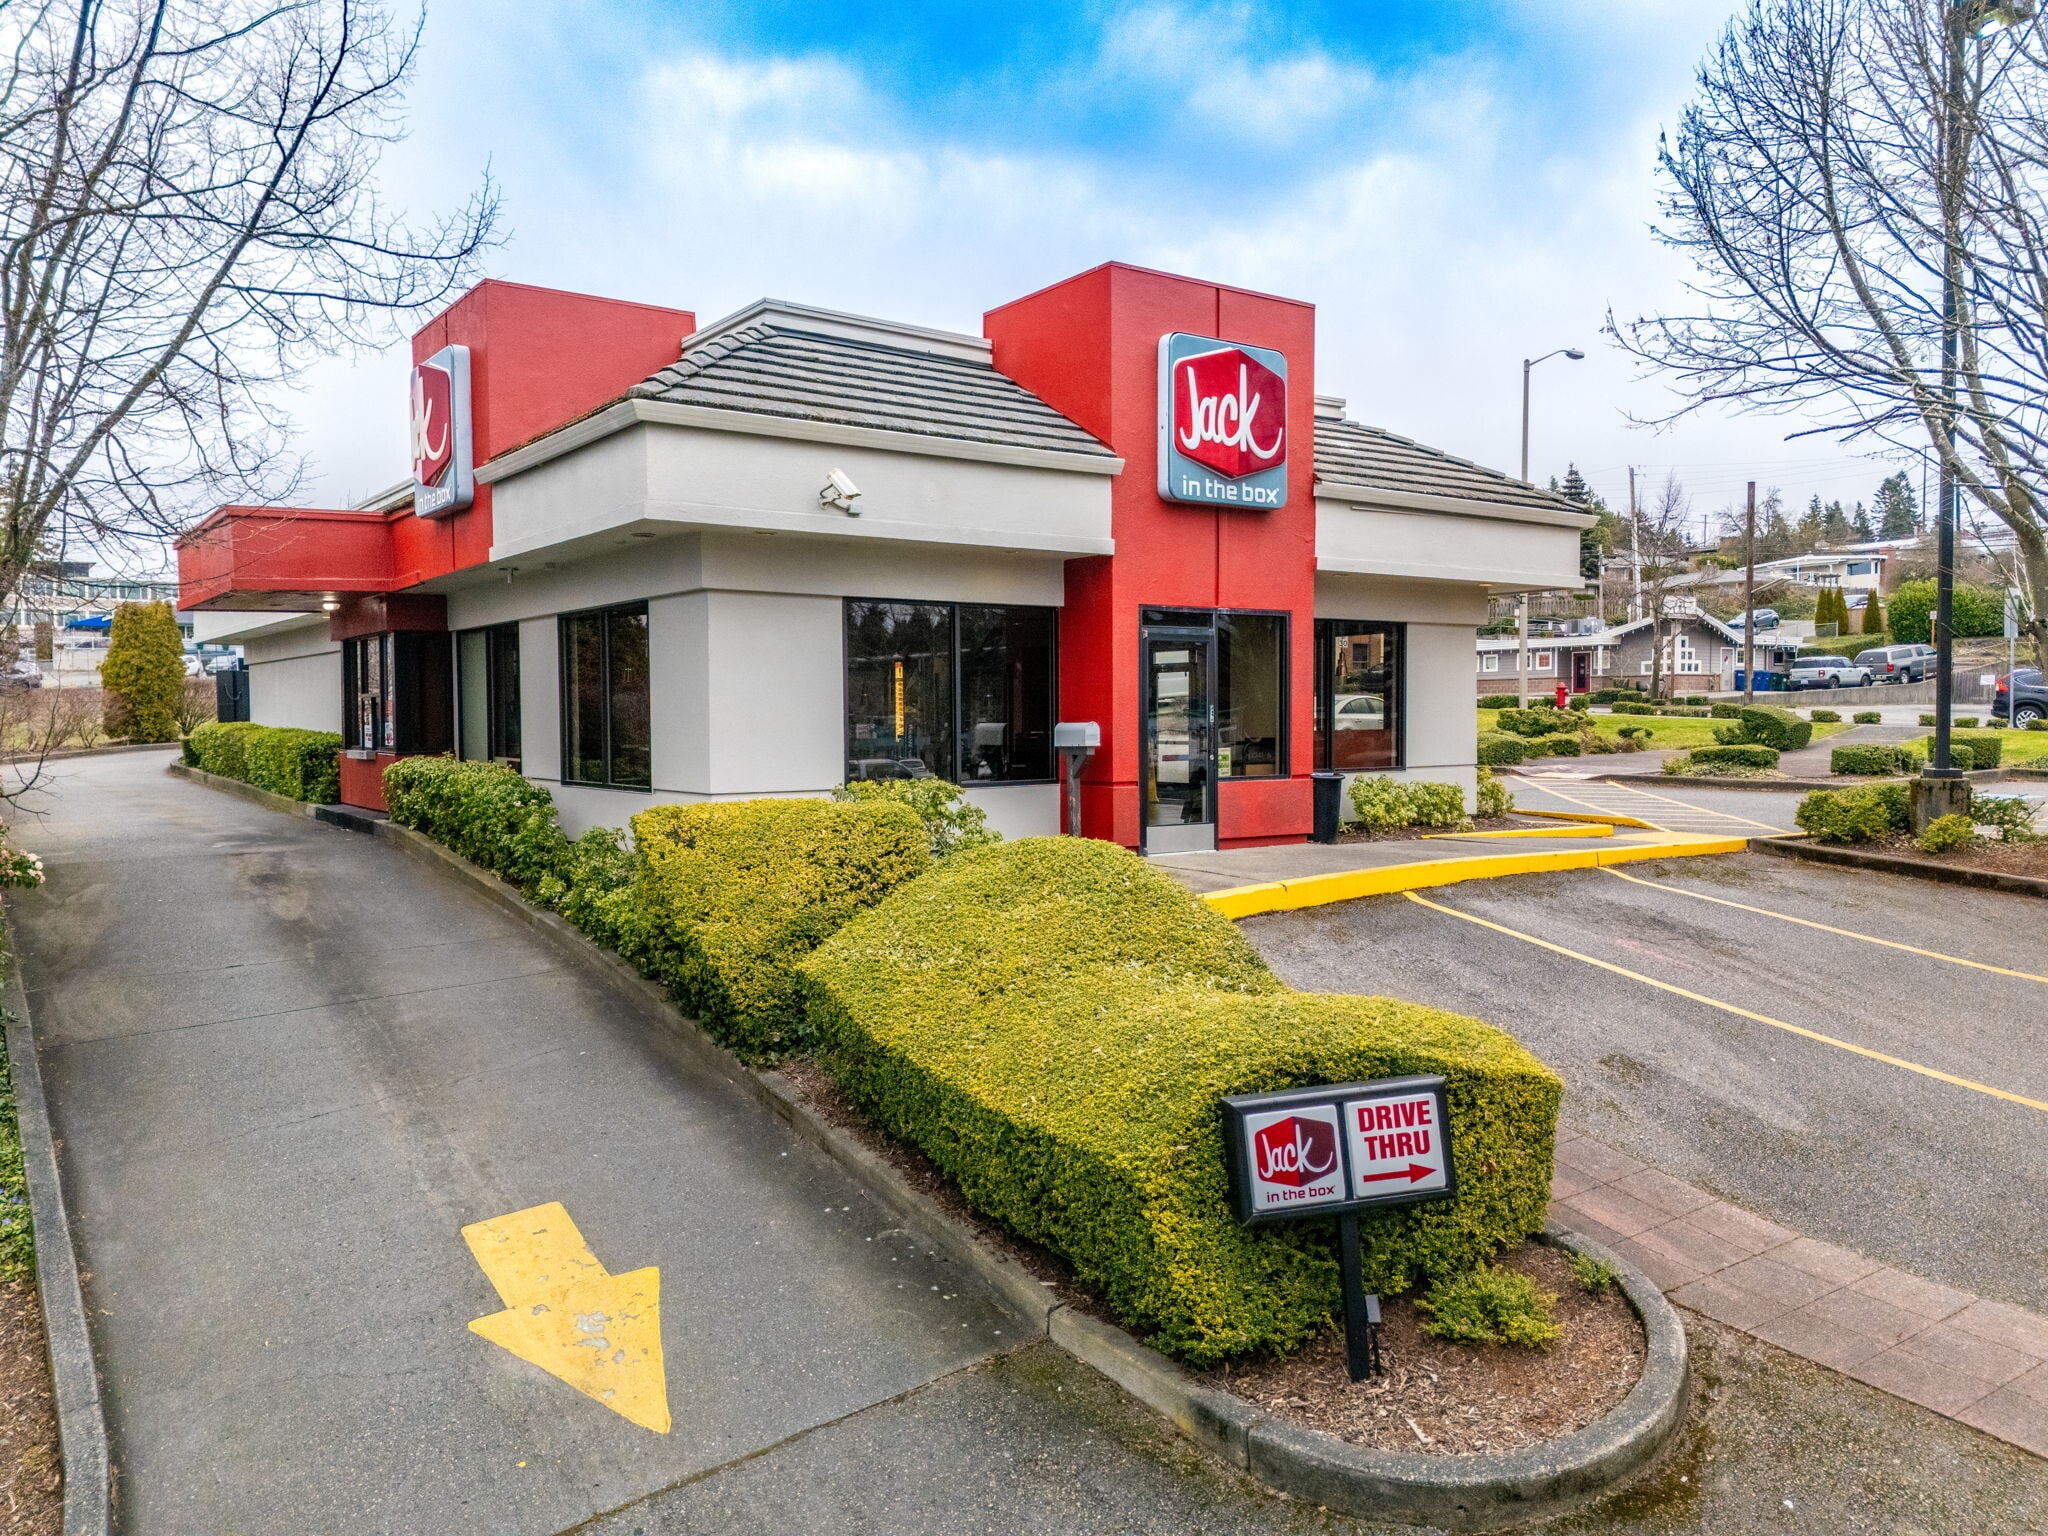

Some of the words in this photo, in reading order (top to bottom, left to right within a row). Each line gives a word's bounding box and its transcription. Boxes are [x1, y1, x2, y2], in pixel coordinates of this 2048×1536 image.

[1180, 364, 1282, 459] Jack
[437, 487, 451, 504] box
[1183, 475, 1200, 496] in
[1205, 478, 1238, 499] the
[1242, 482, 1279, 504] box
[1358, 1101, 1432, 1132] DRIVE
[1260, 1125, 1333, 1178] Jack
[1364, 1130, 1431, 1161] THRU
[1267, 1192, 1279, 1203] in
[1283, 1190, 1306, 1201] the
[1309, 1185, 1335, 1198] box
